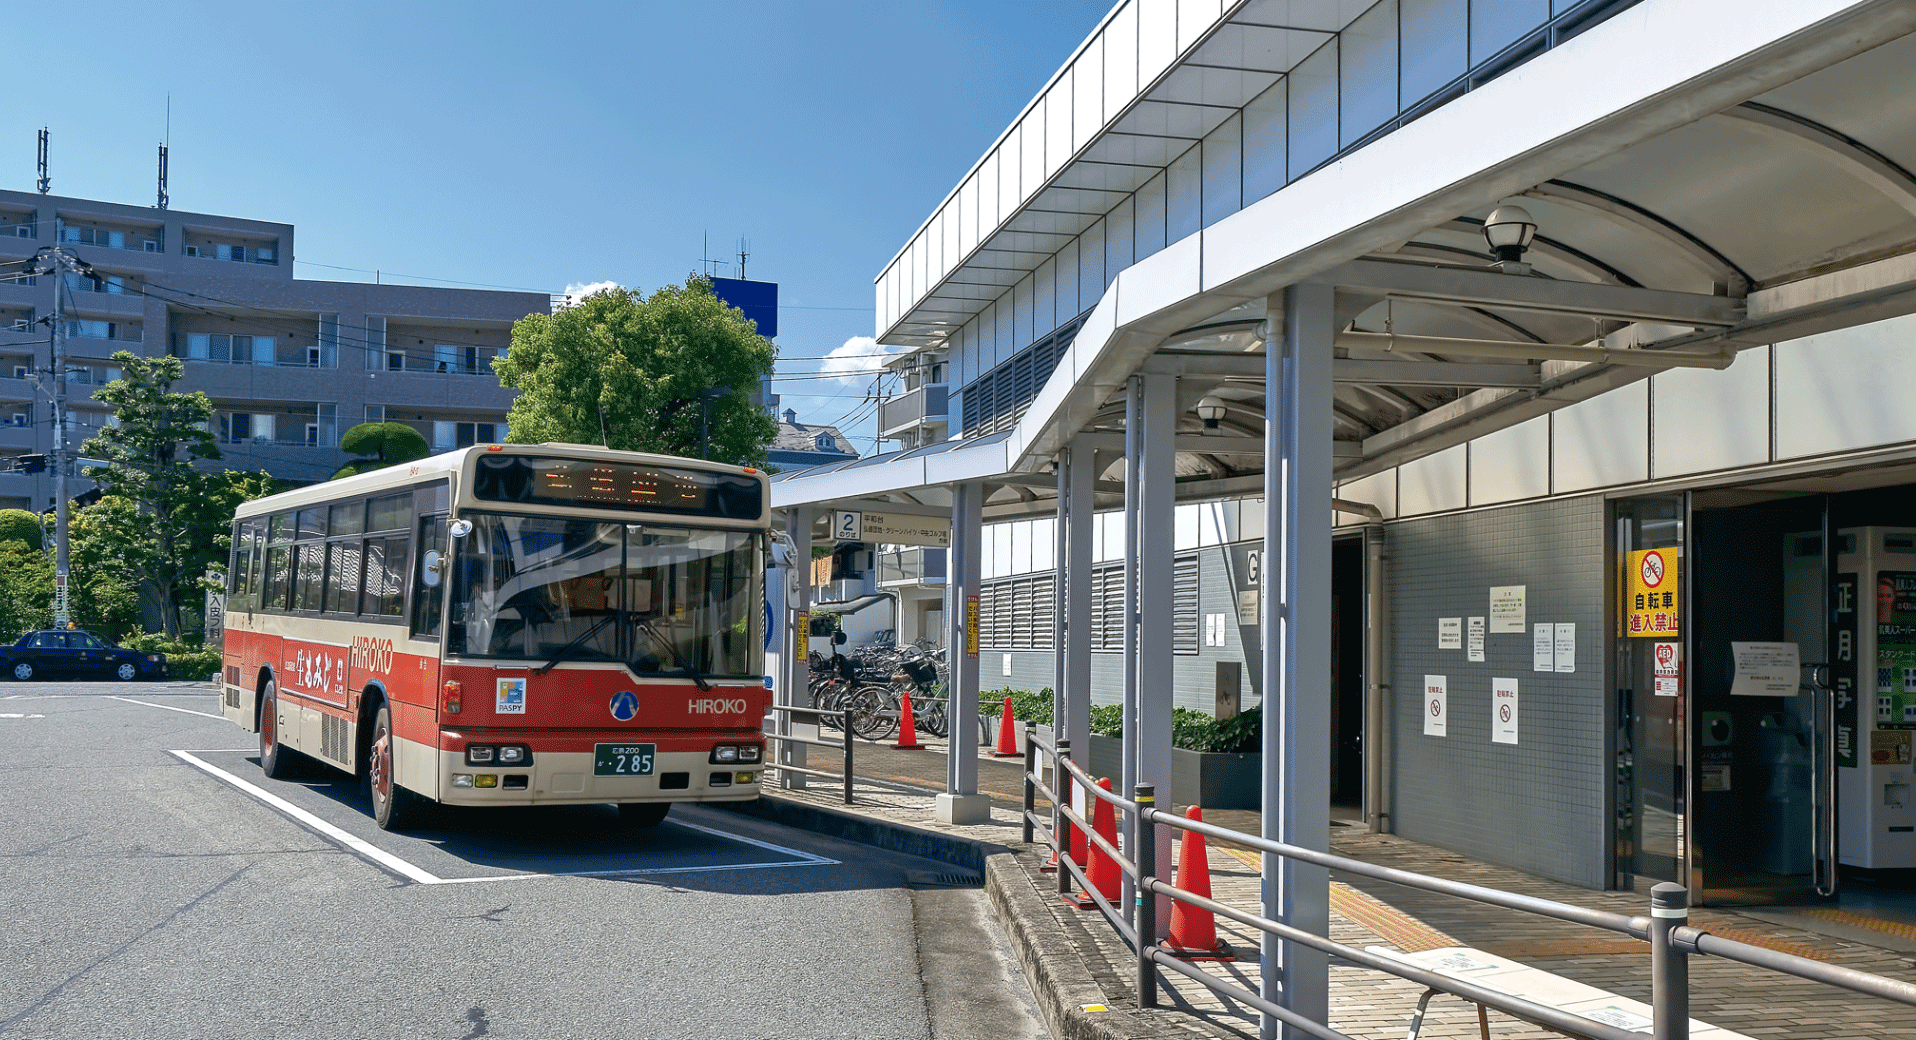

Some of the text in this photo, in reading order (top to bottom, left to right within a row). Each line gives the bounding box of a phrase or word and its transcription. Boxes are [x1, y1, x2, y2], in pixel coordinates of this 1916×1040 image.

[843, 513, 854, 531] 2
[863, 514, 884, 524] 平和台
[838, 530, 856, 538] のりば
[1635, 590, 1673, 610] 自転車
[209, 590, 221, 638] 入皮フ科
[1629, 612, 1678, 632] 進入禁止
[350, 635, 394, 675] HIROKO
[1658, 649, 1671, 658] AED
[498, 704, 523, 712] PASPY
[688, 698, 747, 714] HIROKO
